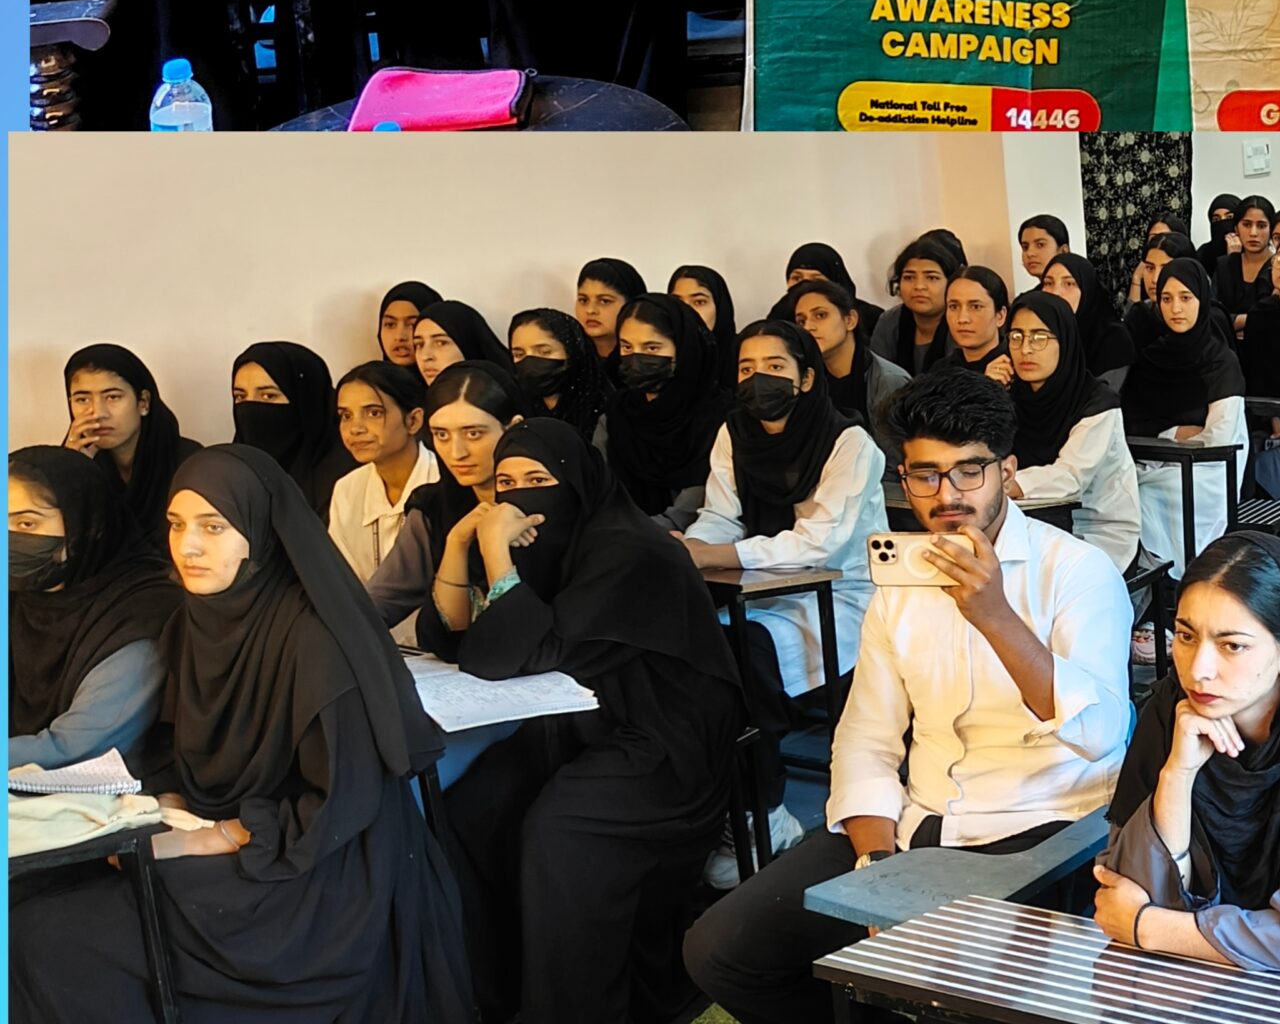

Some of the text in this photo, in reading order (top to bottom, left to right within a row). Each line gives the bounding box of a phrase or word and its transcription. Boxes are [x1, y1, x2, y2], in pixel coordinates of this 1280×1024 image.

[881, 30, 1059, 65] CAMPAIGN
[870, 99, 967, 112] National Toll Free
[858, 112, 978, 127] De-addiction Helpline
[1005, 107, 1080, 129] 14446
